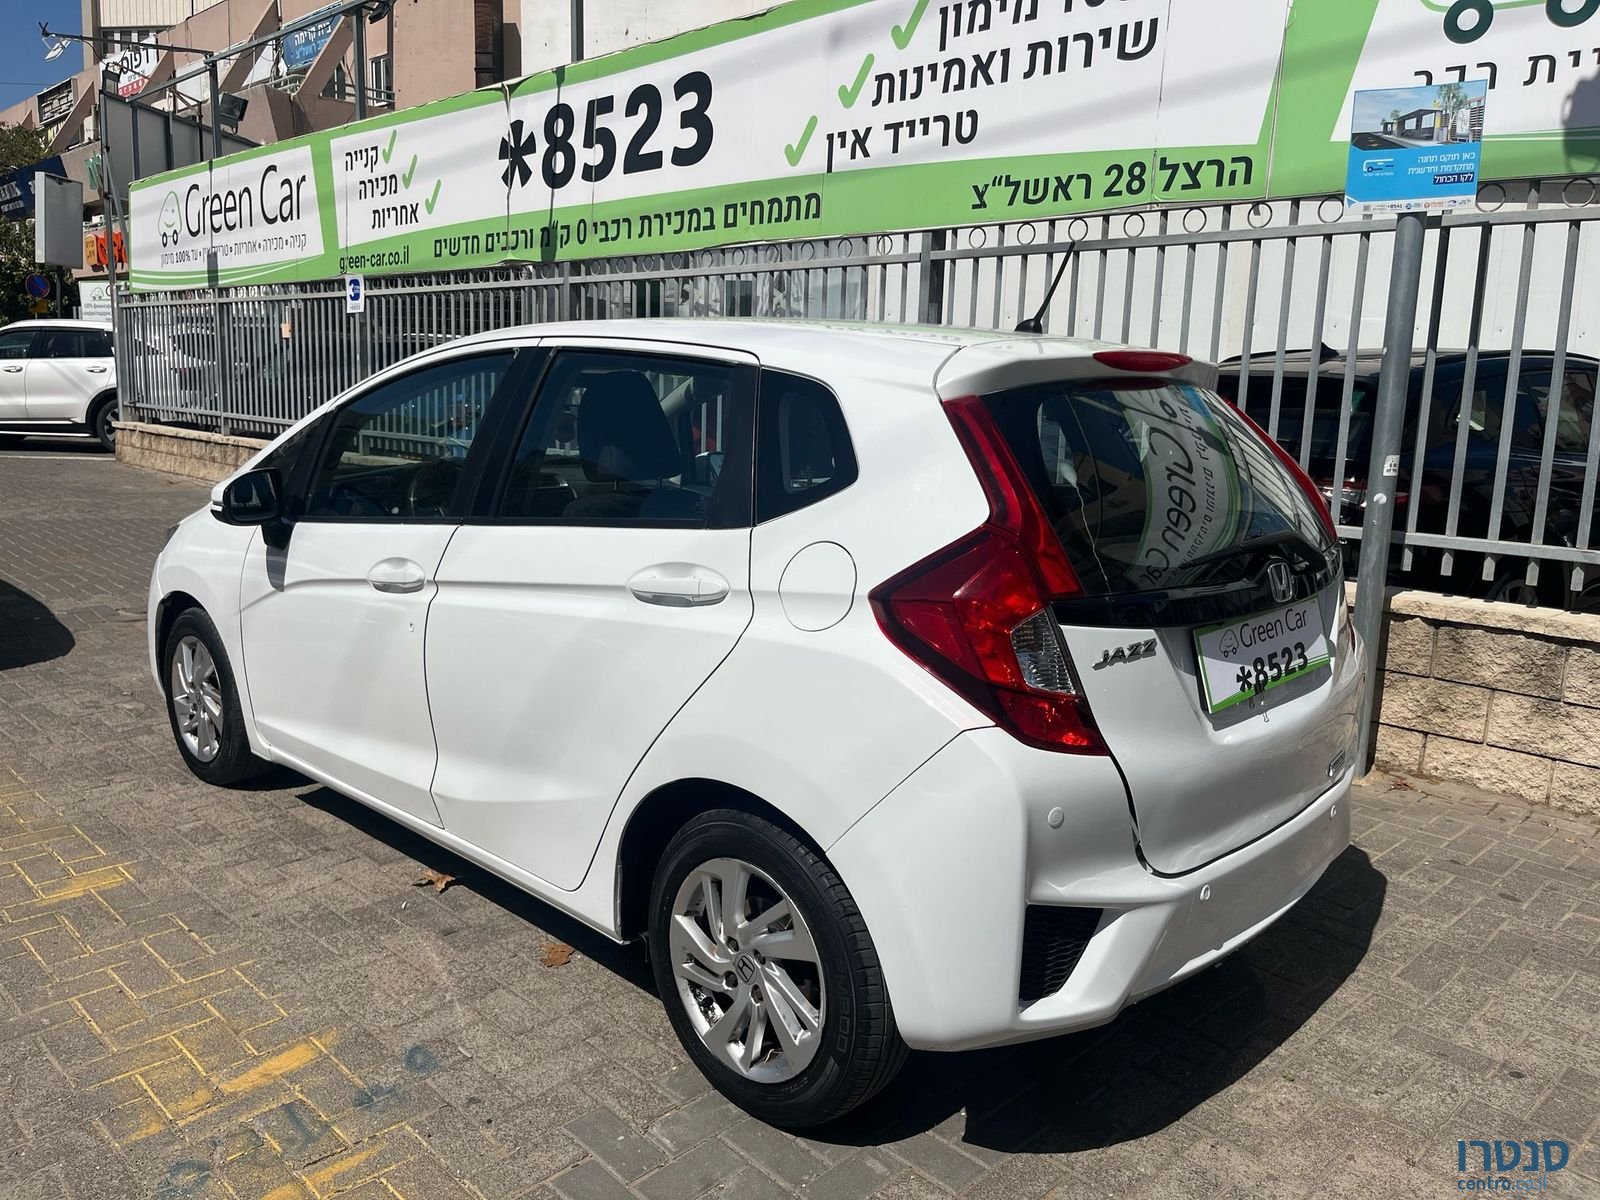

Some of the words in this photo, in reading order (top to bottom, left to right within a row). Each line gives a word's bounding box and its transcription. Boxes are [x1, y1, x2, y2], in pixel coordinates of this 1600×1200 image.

[1022, 17, 1159, 80] שירות
[871, 47, 1010, 108] ואמינות
[883, 108, 979, 155] טרייד
[345, 146, 379, 173] קנייה
[825, 125, 873, 174] אין
[359, 174, 398, 200] מכירה
[1103, 161, 1147, 198] 28
[1158, 156, 1253, 192] הרצל
[185, 183, 253, 238] Green
[259, 164, 307, 225] Car
[371, 202, 419, 229] אחריות
[723, 192, 821, 229] מתמחים
[576, 218, 588, 245] 0
[593, 217, 632, 243] רכבי
[638, 206, 716, 239] במכירת
[234, 240, 258, 256] אחריות
[262, 236, 284, 252] מכירה
[290, 233, 307, 252] קניה
[434, 234, 480, 258] חדשים
[485, 228, 534, 253] ורכבים
[1238, 618, 1284, 648] Green
[1284, 608, 1307, 630] Car
[1091, 637, 1158, 671] JAZZ
